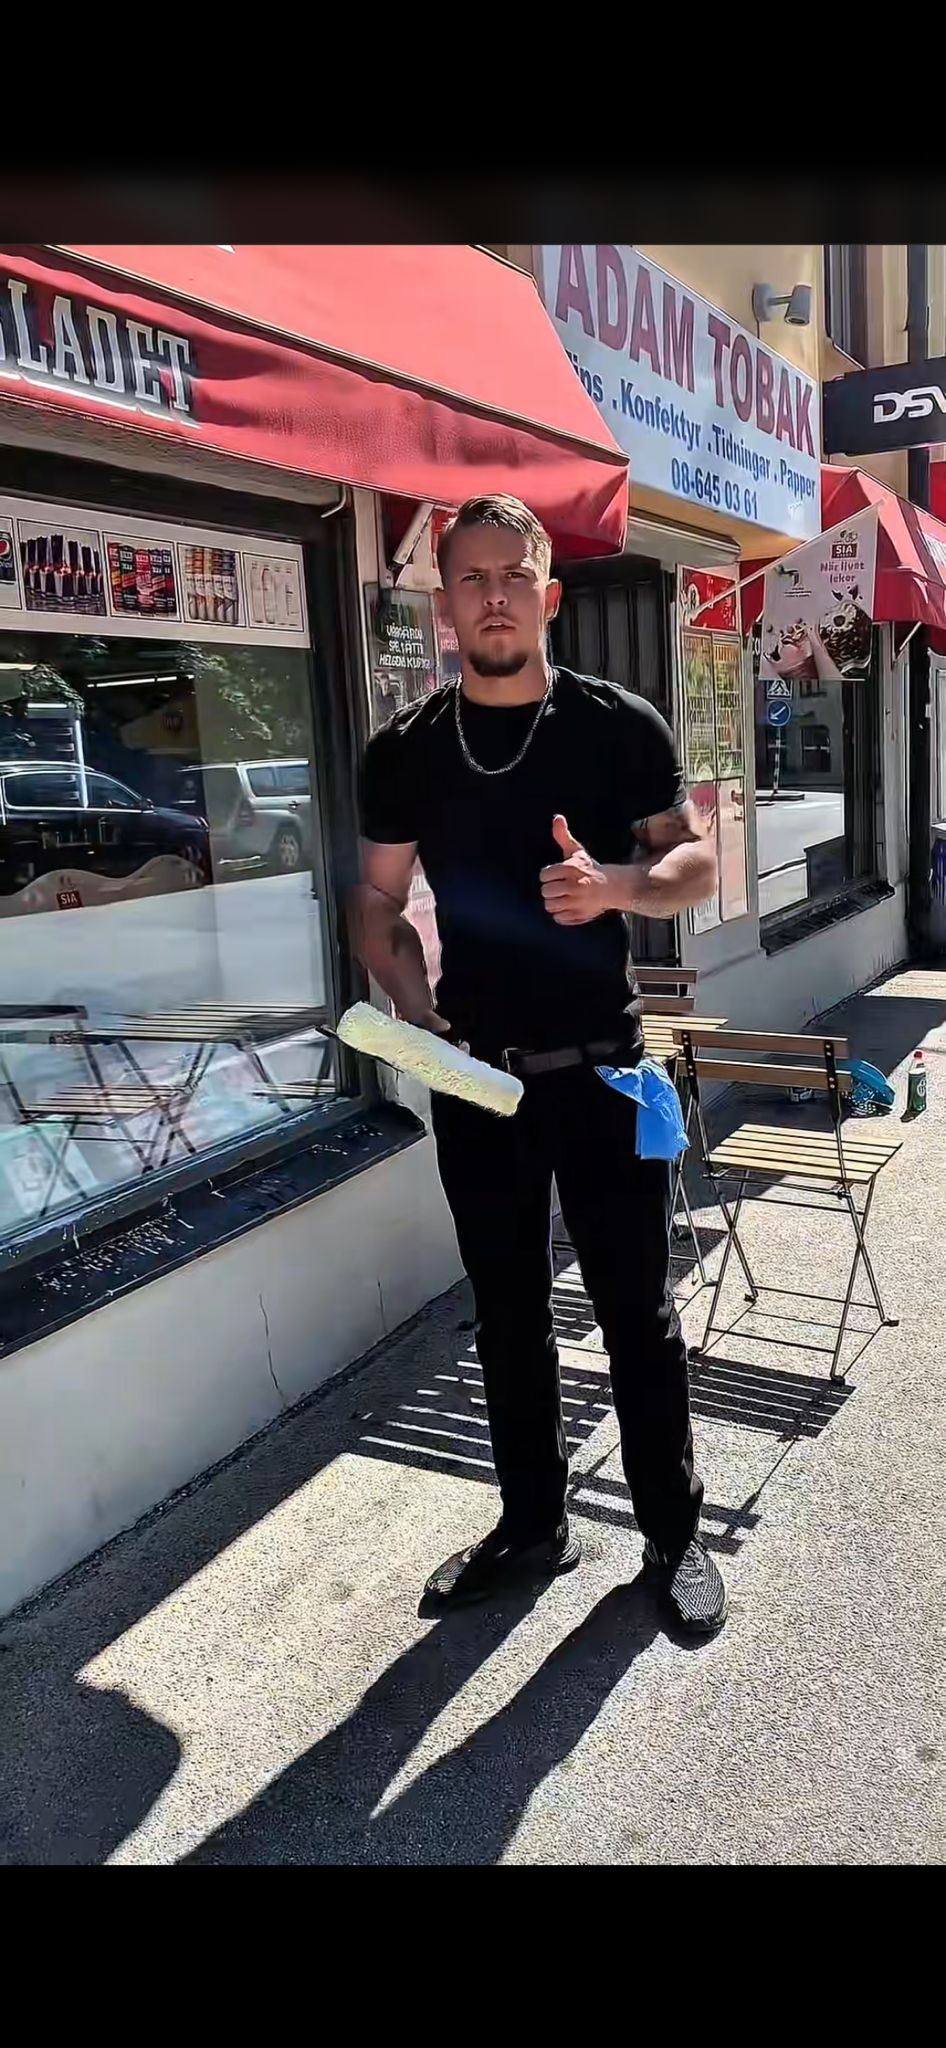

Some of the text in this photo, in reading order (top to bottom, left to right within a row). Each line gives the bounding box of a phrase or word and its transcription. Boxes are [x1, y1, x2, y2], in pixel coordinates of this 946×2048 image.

[0, 278, 191, 412] LADET
[555, 244, 816, 459] ADAM TOBAK
[671, 457, 759, 520] 08-645 03 61
[780, 458, 816, 499] Papper
[835, 545, 853, 554] SIA
[60, 893, 78, 905] SIA
